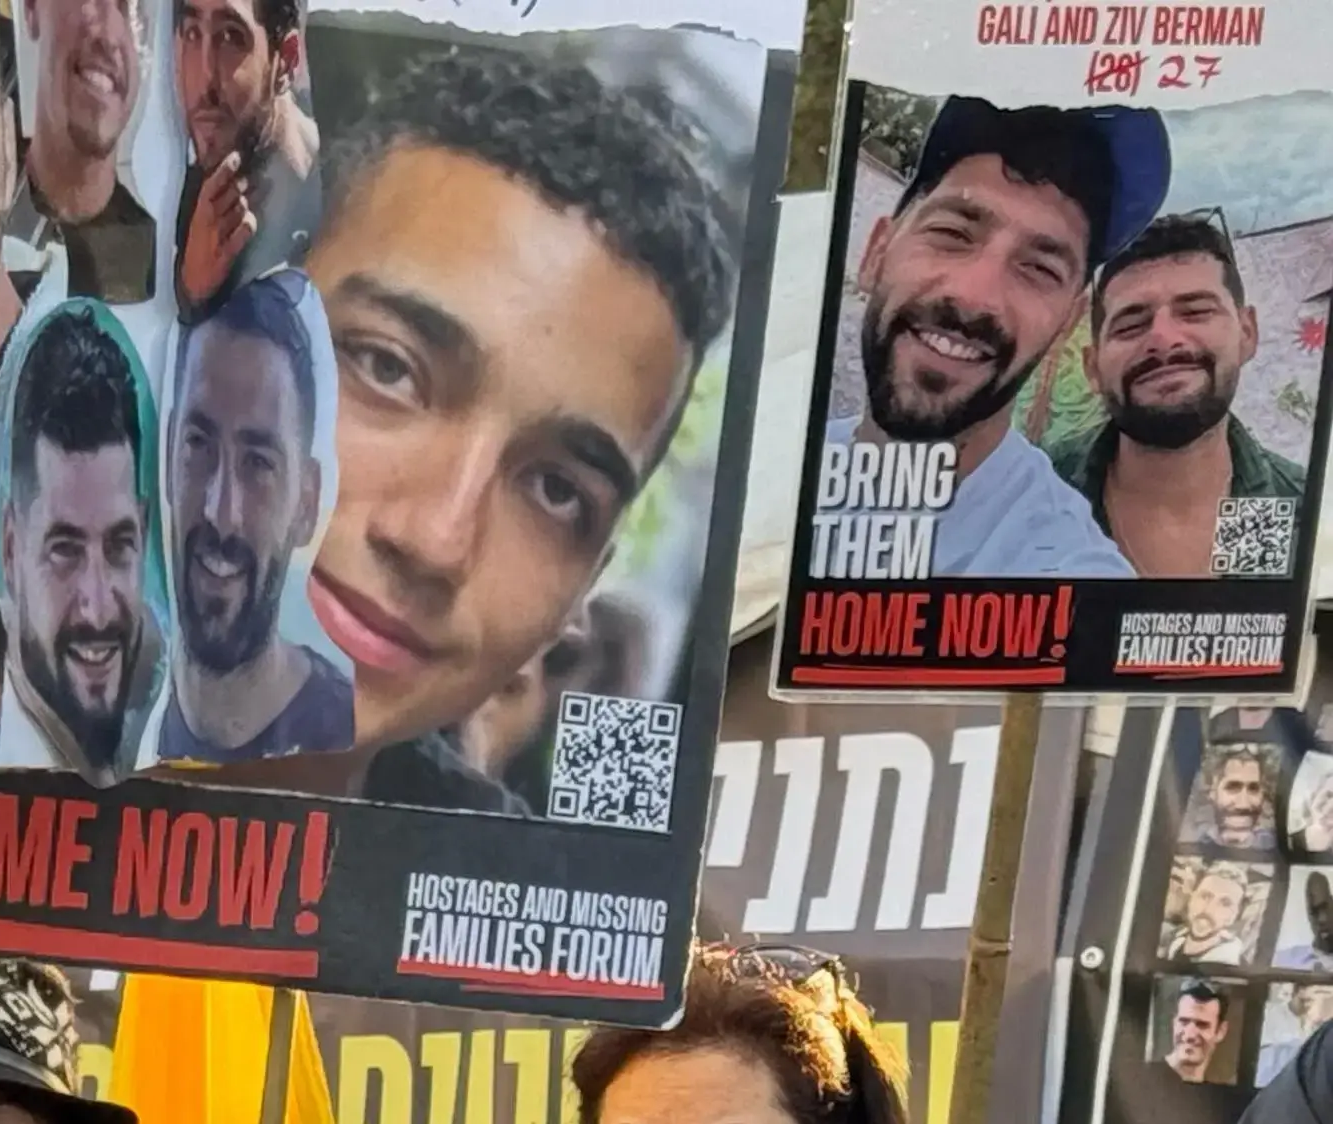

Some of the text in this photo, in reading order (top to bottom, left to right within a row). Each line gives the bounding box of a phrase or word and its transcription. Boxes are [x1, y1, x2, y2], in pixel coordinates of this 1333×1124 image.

[977, 5, 1265, 47] GALI AND ZIV BERMAN
[1157, 55, 1222, 89] 27
[817, 442, 958, 508] BRING
[807, 515, 937, 580] THEM
[799, 585, 1074, 660] HOME NOW!
[1117, 635, 1285, 667] FAMILIES FORUM
[1121, 613, 1286, 636] HOSTAGES AND MISSING
[112, 811, 330, 937] NOW!
[407, 872, 668, 935] HOSTAGES AND MISSING
[401, 909, 665, 989] FAMILIES FORUM
